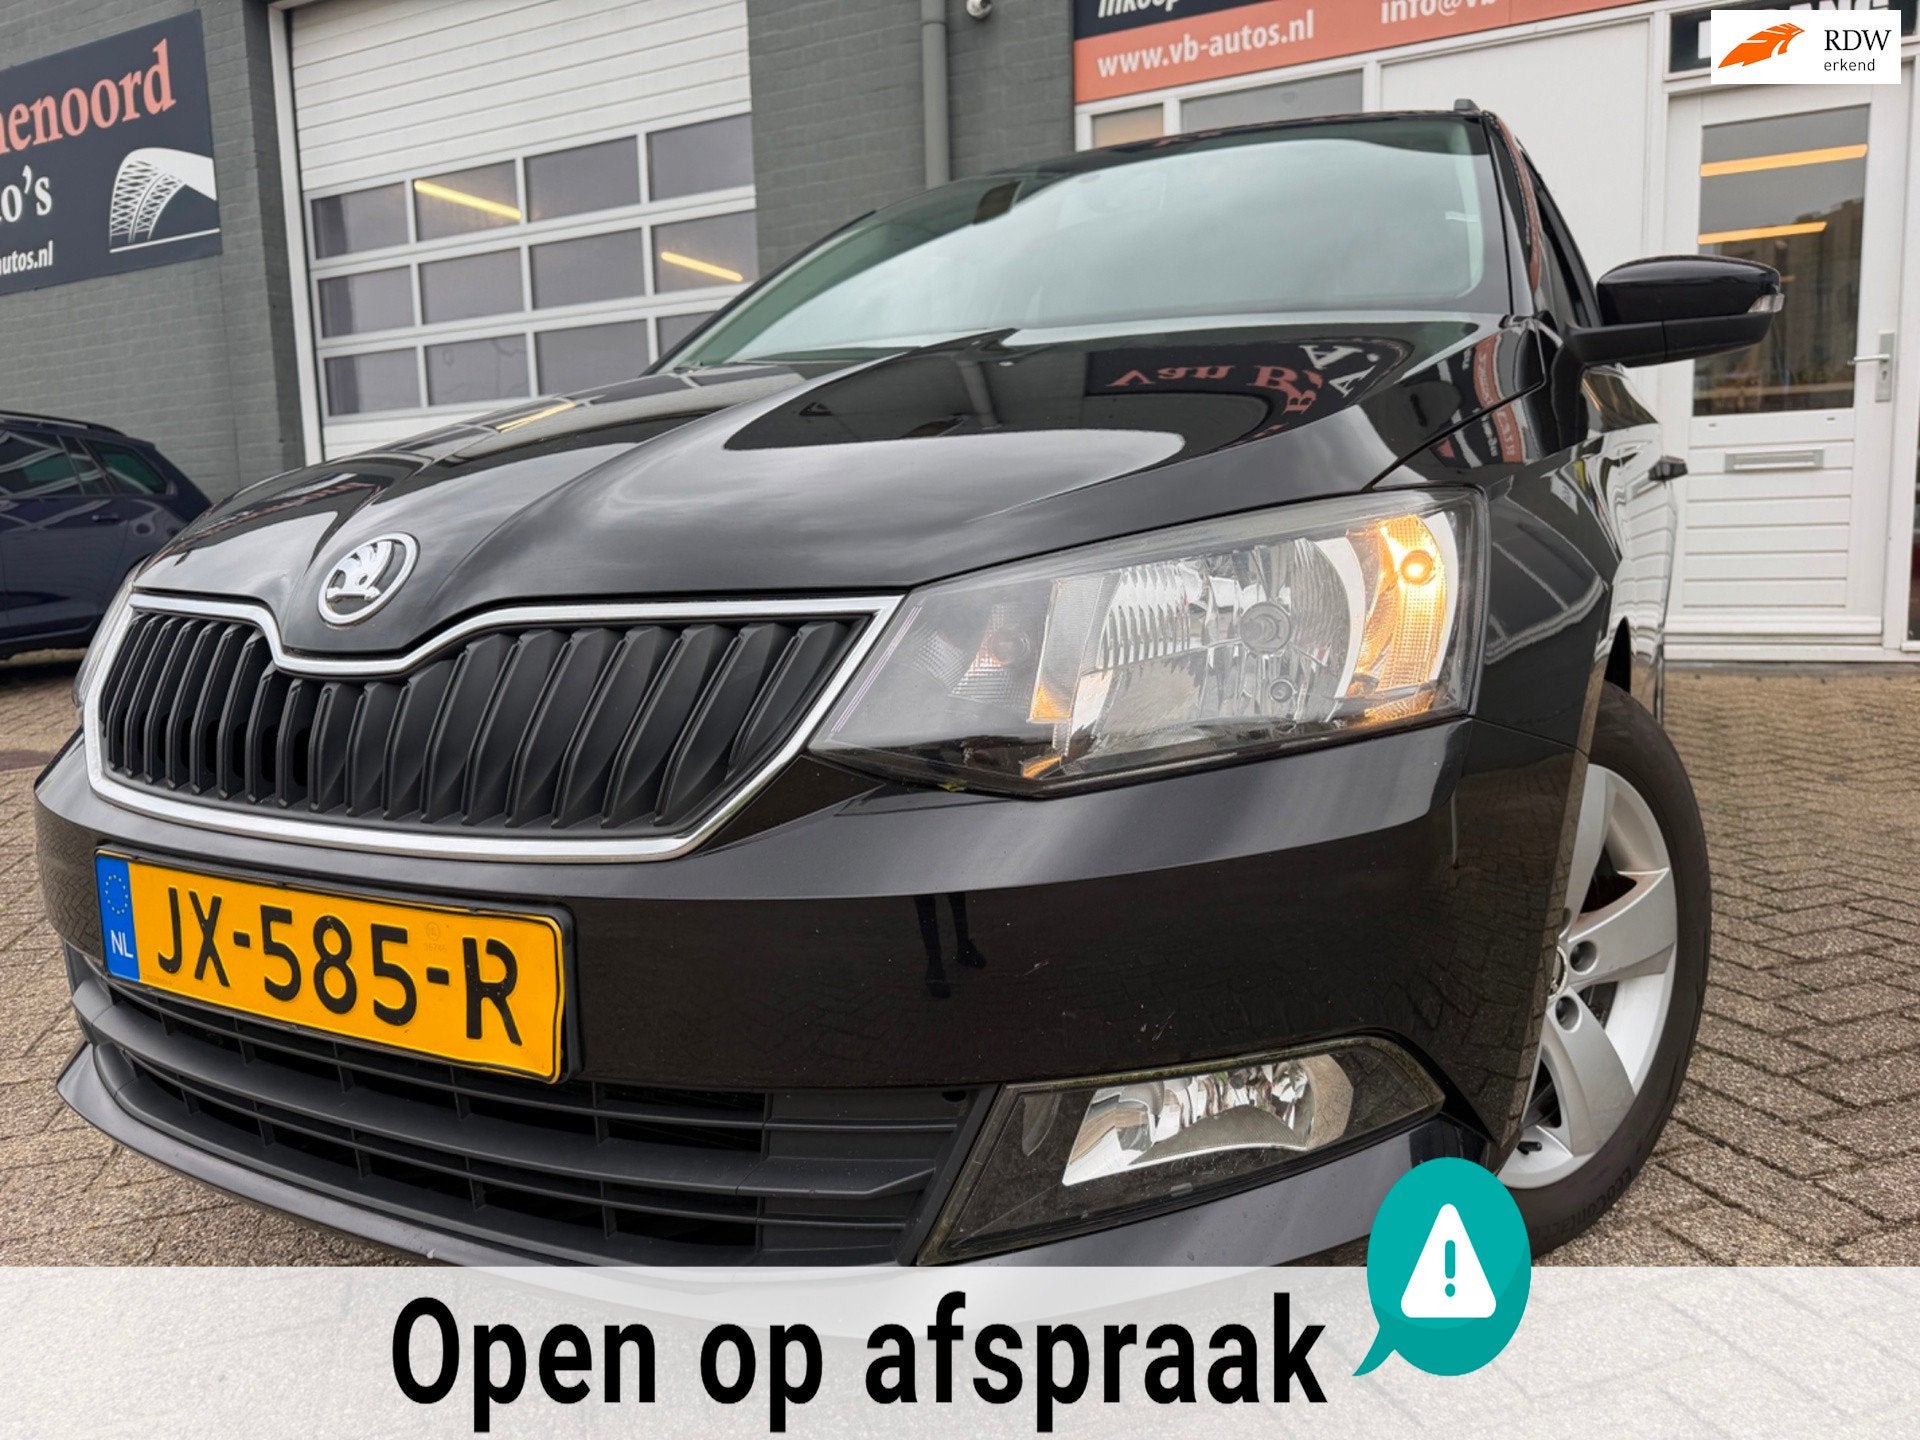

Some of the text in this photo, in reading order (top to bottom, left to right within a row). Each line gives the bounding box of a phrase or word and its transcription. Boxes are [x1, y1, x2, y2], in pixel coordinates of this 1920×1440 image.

[1381, 0, 1497, 24] info@
[1097, 10, 1315, 78] www.vb-autos.nl
[0, 165, 52, 223] o's
[111, 929, 134, 960] NL
[157, 886, 523, 1046] JX-585-R
